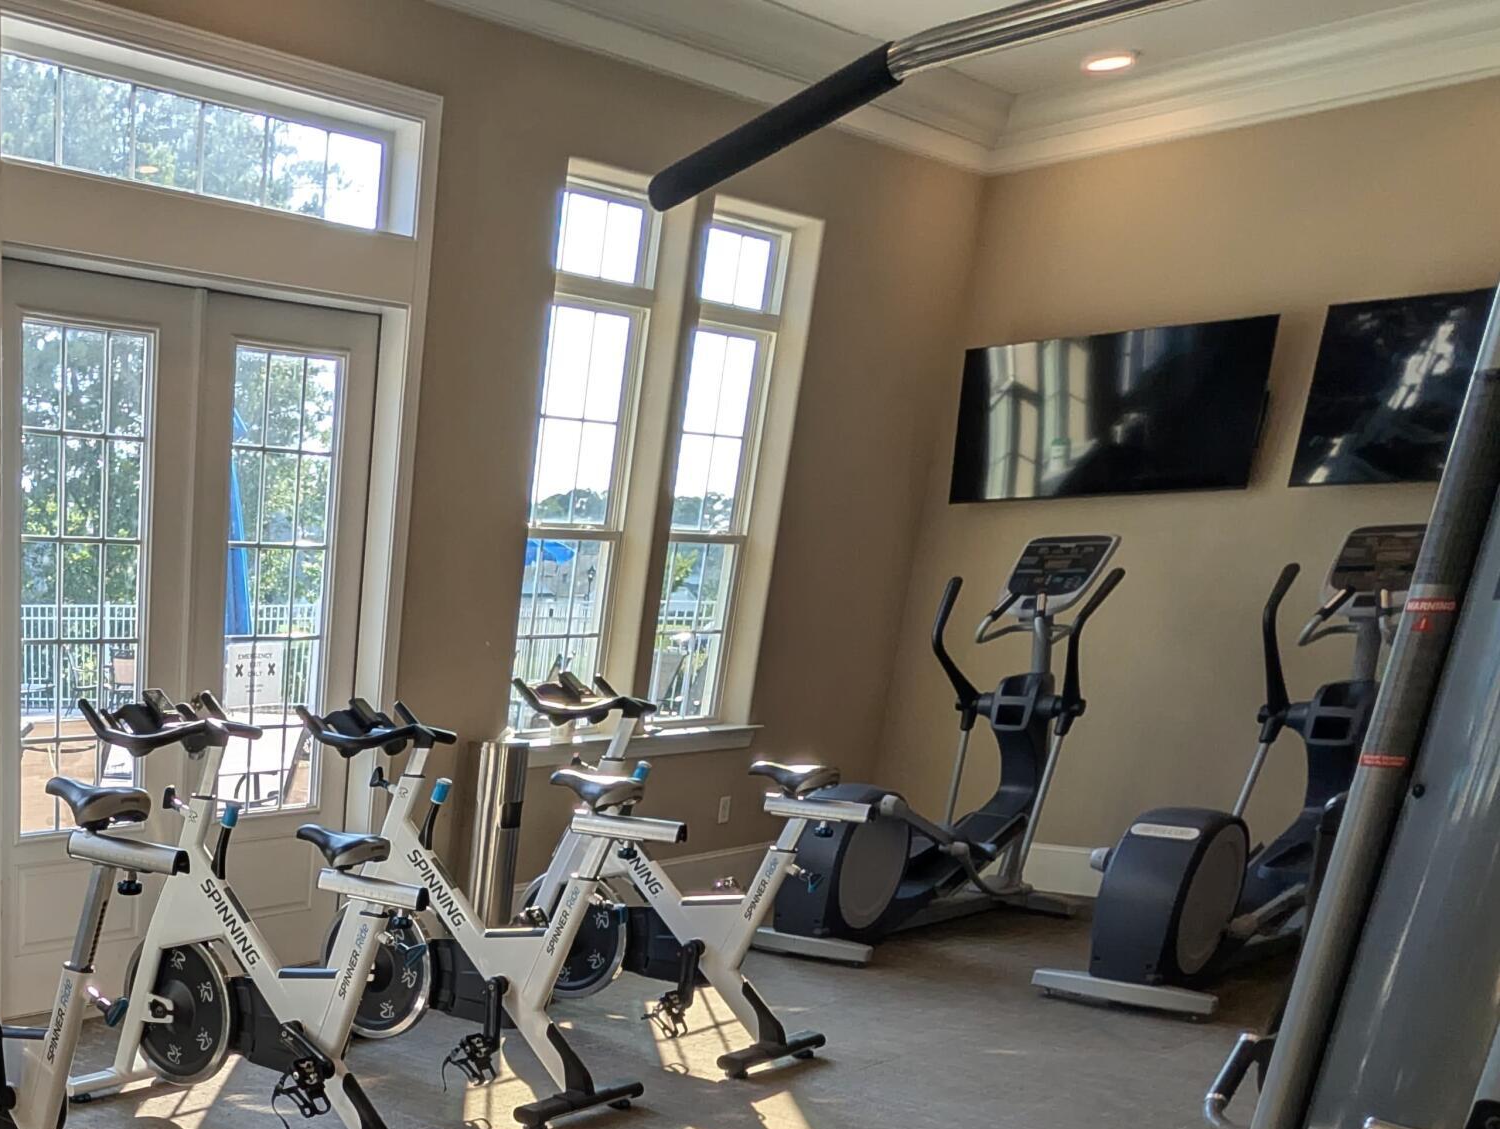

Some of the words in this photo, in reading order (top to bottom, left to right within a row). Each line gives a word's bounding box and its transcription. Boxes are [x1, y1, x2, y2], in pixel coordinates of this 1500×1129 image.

[1406, 601, 1457, 611] WARNING
[238, 652, 273, 660] EMEENCY
[407, 849, 467, 927] SPINNING
[629, 856, 664, 895] NING
[744, 879, 769, 921] SPINNER
[200, 878, 260, 966] SPINNING
[546, 909, 570, 957] SPINNER
[566, 886, 580, 909] Ride
[338, 949, 360, 1000] SPINNER
[355, 923, 369, 950] Ride
[46, 1007, 66, 1064] SPINNER
[61, 978, 73, 1008] Ride
